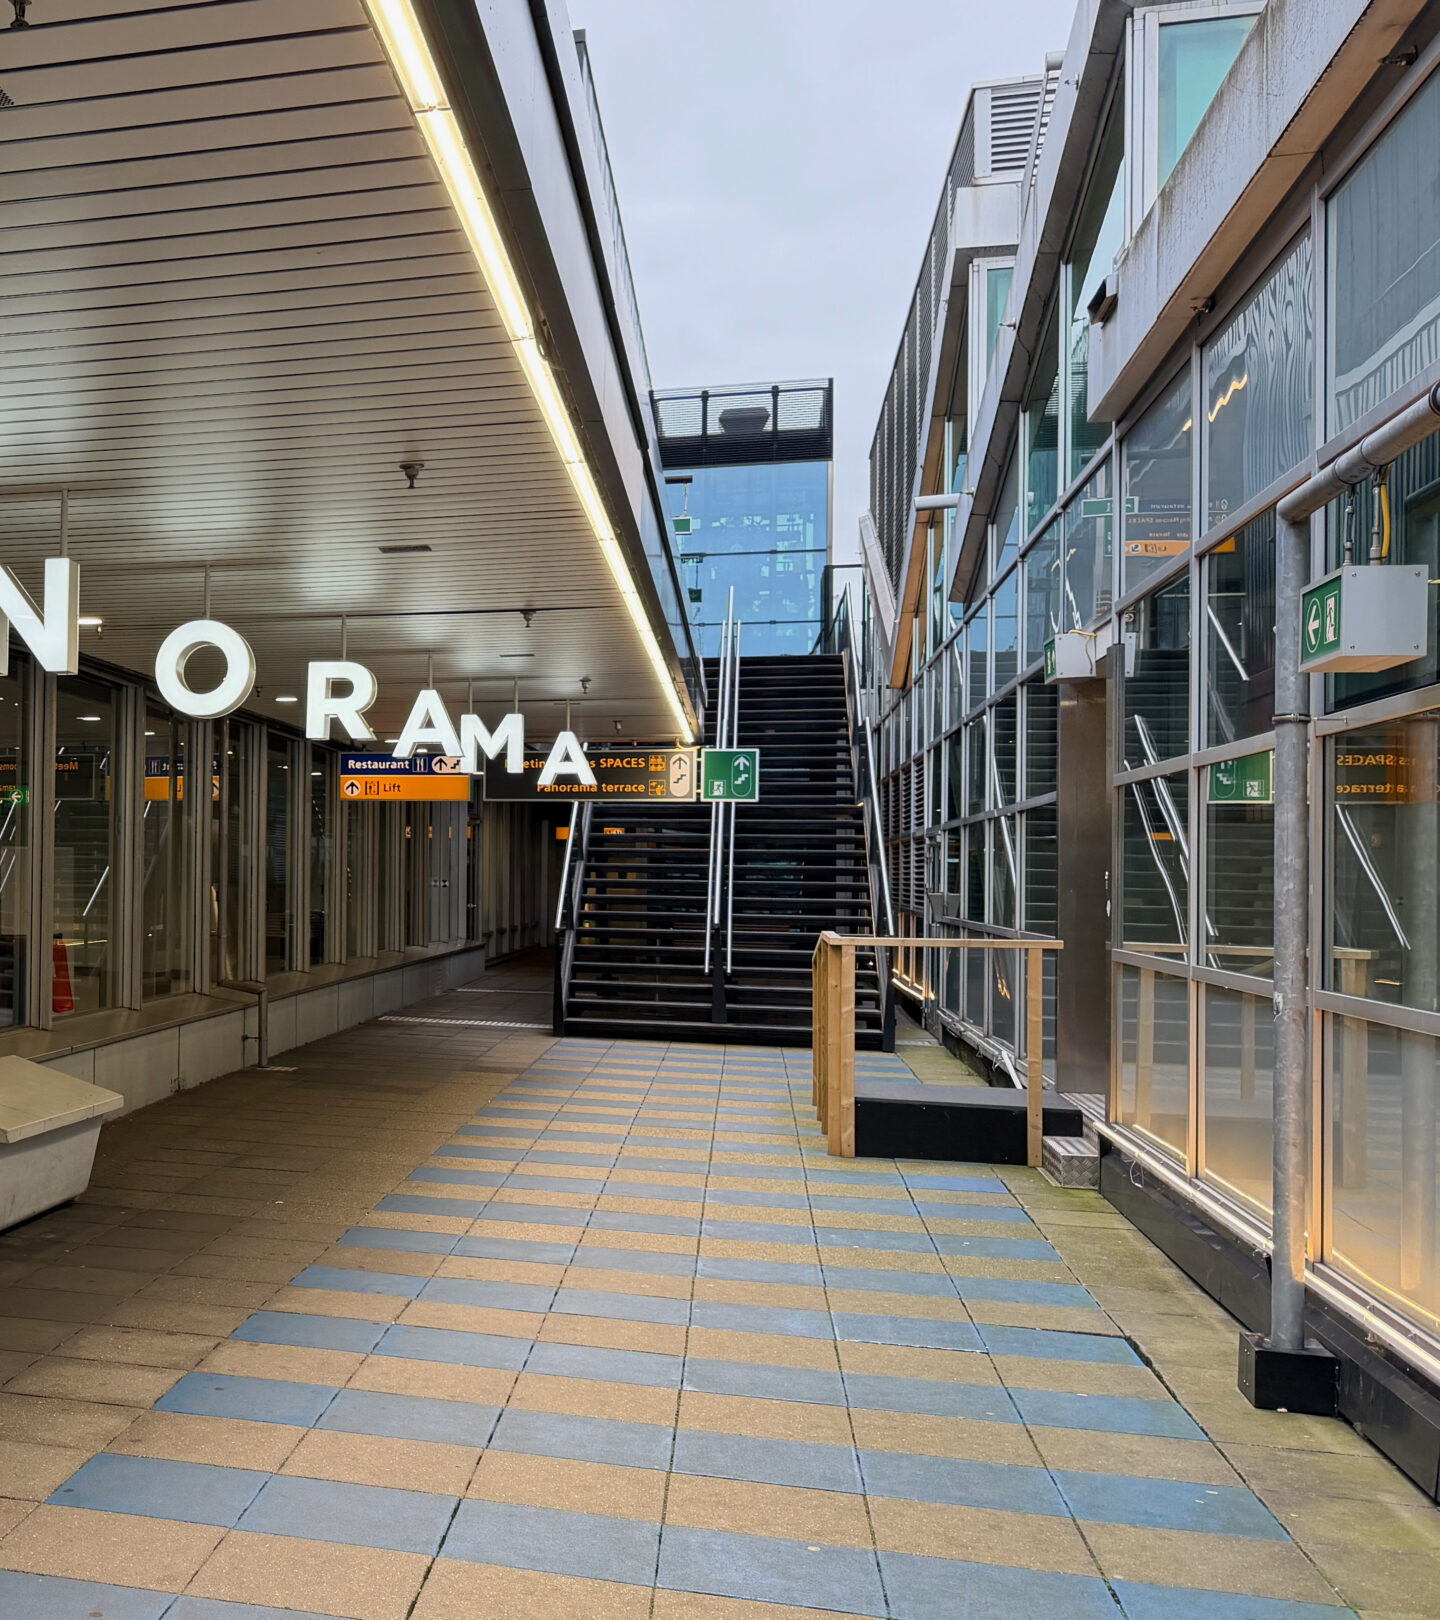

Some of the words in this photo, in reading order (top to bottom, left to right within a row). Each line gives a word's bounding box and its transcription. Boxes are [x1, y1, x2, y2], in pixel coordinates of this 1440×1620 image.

[348, 759, 410, 769] Restaurant
[600, 757, 646, 768] SPACES
[383, 783, 401, 792] Lift
[602, 783, 647, 793] terrace
